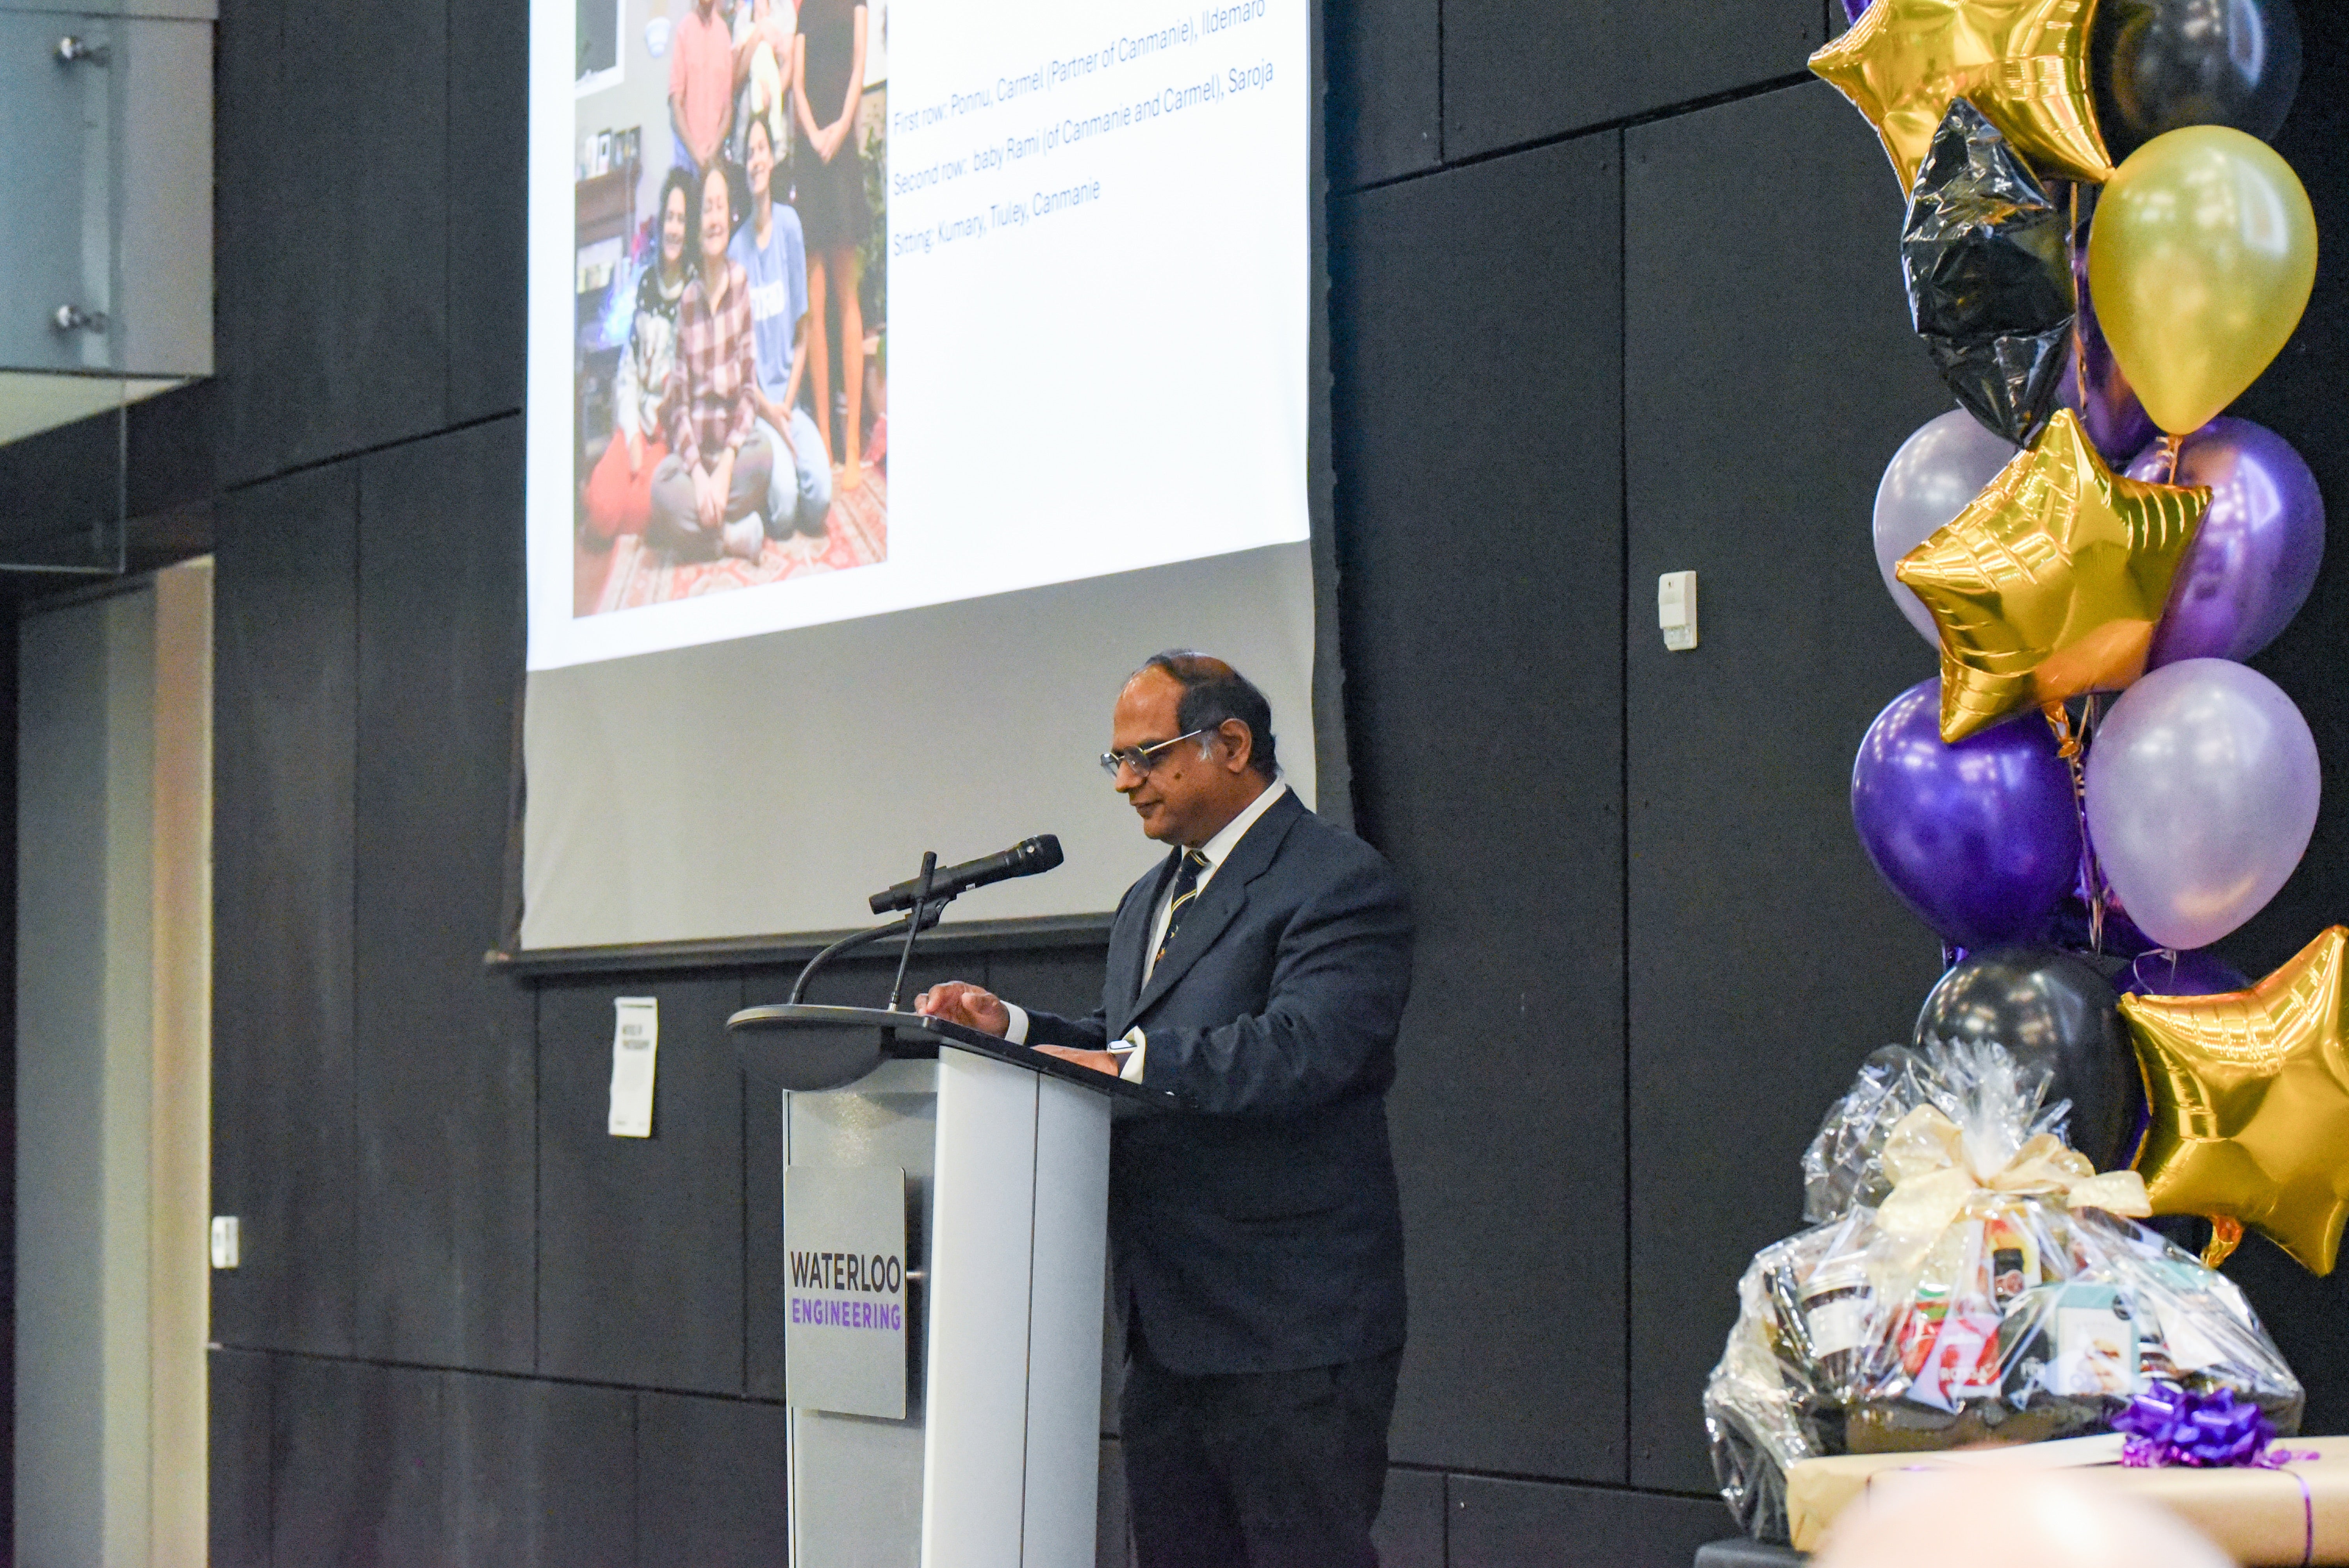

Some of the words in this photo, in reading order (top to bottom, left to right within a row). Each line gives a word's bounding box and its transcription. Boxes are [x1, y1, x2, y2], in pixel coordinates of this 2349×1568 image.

[894, 110, 919, 135] First
[922, 103, 947, 127] row:
[951, 89, 993, 117] Ponnu,
[997, 64, 1043, 101] Carmel
[1047, 53, 1098, 92] (Partner
[1102, 41, 1115, 67] of
[1118, 16, 1198, 62] Canmanie),
[1202, 0, 1265, 35] Ildemaro
[894, 161, 939, 196] Second
[942, 158, 967, 181] row:
[974, 144, 1004, 171] baby
[1007, 128, 1039, 161] Rami
[1043, 123, 1060, 157] (of
[1063, 103, 1131, 144] Canmanie
[1135, 91, 1160, 122] and
[1164, 73, 1224, 112] Carmel),
[1228, 58, 1273, 93] Saroja
[938, 214, 986, 243] Kumary,
[1033, 176, 1100, 216] Canmanie
[791, 1251, 901, 1294] WATERLOO
[793, 1298, 901, 1331] ENGINEERING
